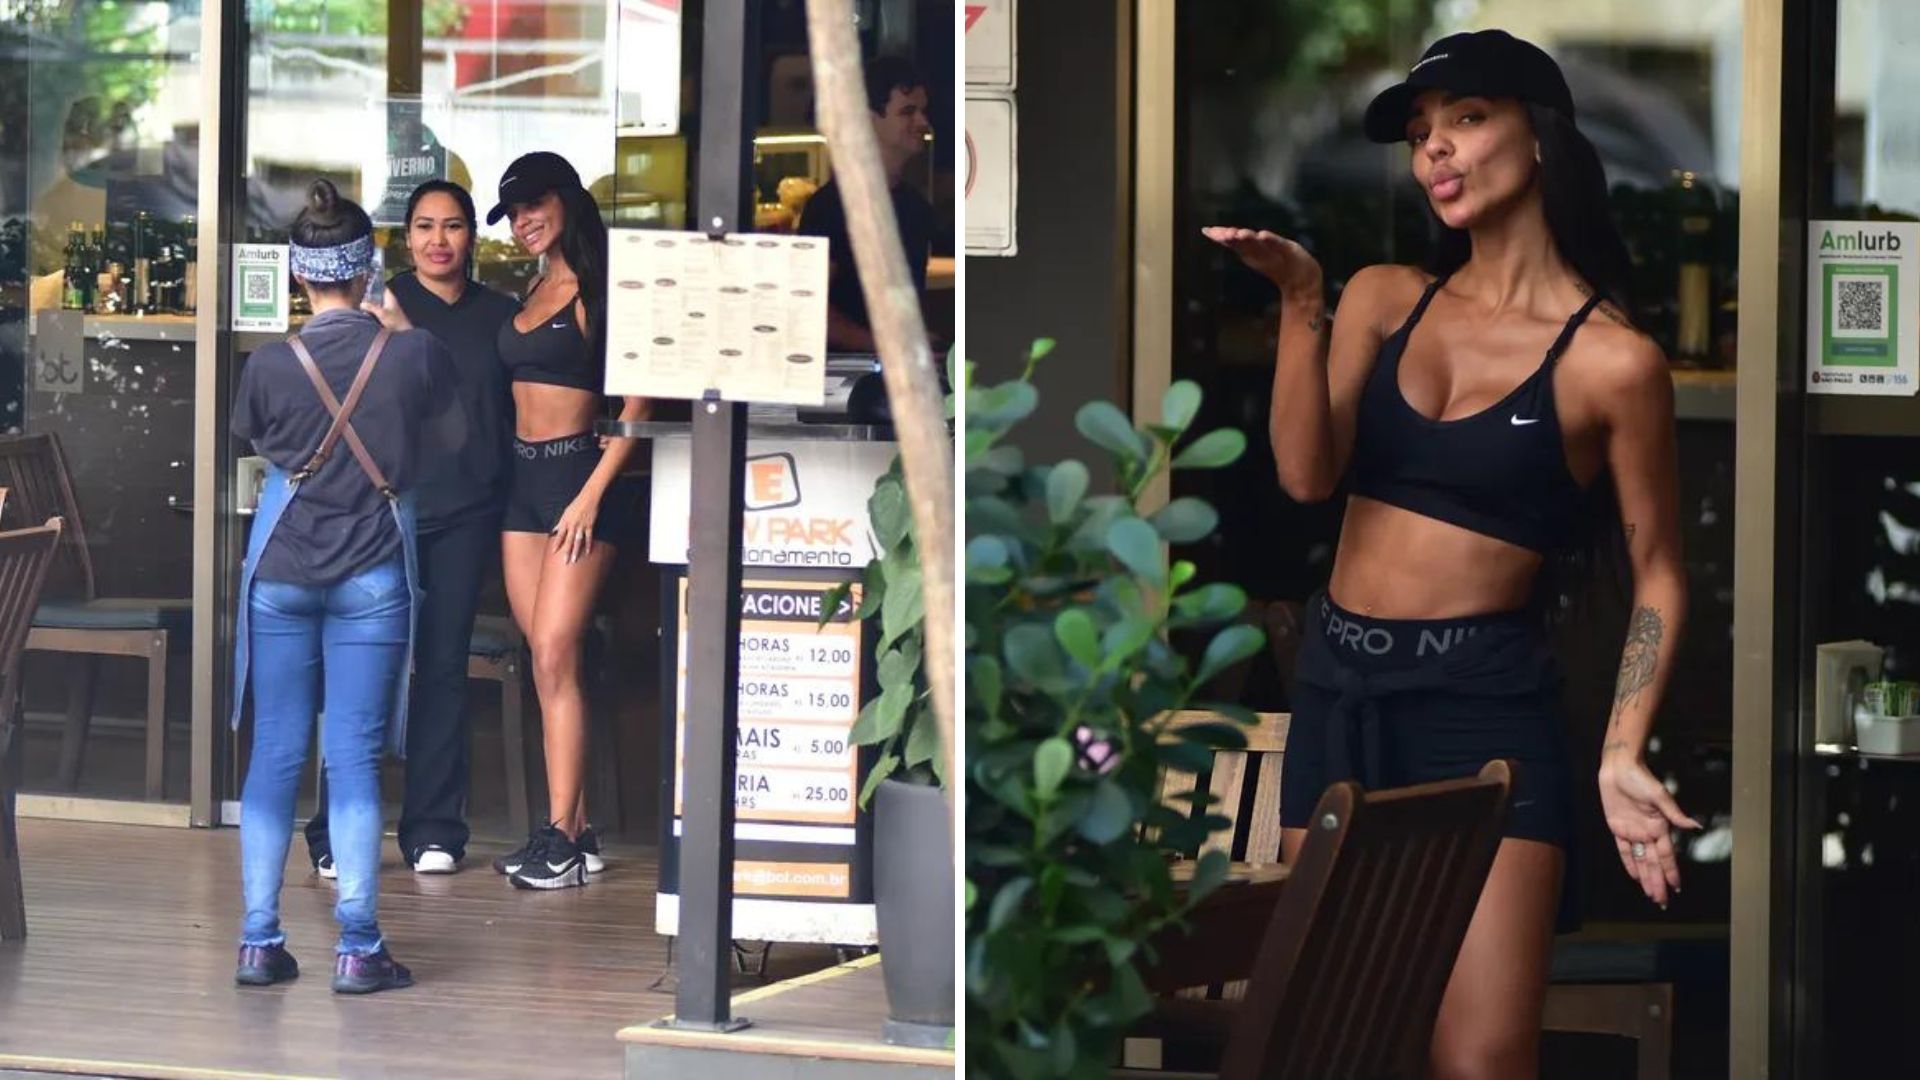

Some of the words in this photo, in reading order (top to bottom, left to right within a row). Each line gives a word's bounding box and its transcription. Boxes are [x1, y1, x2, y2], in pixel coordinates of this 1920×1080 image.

[1820, 230, 1901, 251] Amlurb
[239, 248, 280, 260] Amlurb
[768, 518, 854, 546] PARK
[740, 594, 821, 616] ACIONE
[739, 638, 790, 652] HORAS
[1326, 612, 1394, 655] PRO
[1416, 626, 1477, 657] NI
